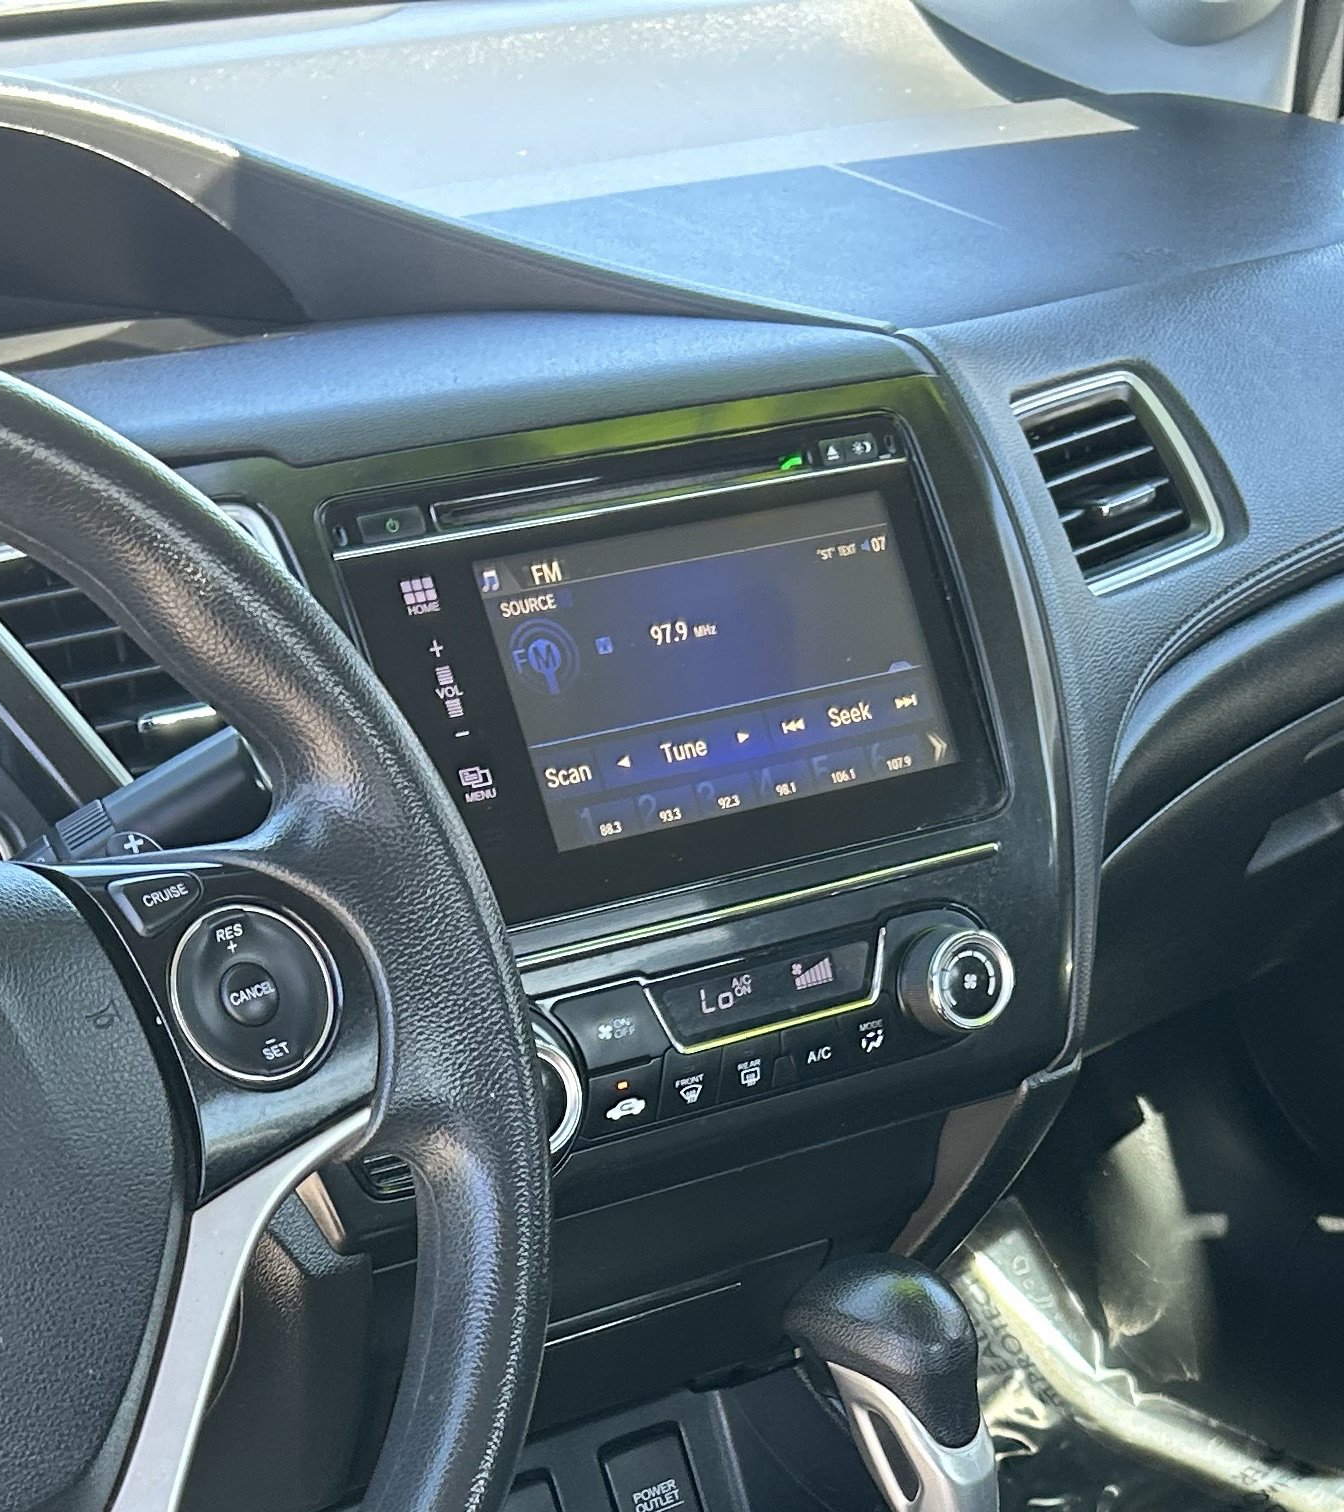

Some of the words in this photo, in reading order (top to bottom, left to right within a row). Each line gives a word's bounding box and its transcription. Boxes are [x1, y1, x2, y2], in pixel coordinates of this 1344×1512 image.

[870, 535, 886, 552] 07
[530, 560, 563, 586] FM
[406, 601, 441, 616] HOME
[500, 593, 558, 618] SOURCE
[650, 621, 689, 646] 97.9
[693, 624, 718, 639] MHz
[435, 685, 464, 701] VOL
[827, 700, 873, 728] Seek
[659, 740, 708, 764] Tune
[885, 755, 912, 772] 107.9
[544, 764, 593, 789] Scan
[830, 768, 857, 784] 106.1
[465, 788, 497, 804] MENU
[774, 781, 797, 797] 98.1
[717, 794, 741, 810] 92.3
[659, 807, 682, 823] 93.3
[599, 820, 623, 837] 88.3
[142, 883, 189, 908] CRUISE
[215, 923, 243, 943] RES
[732, 974, 753, 989] A/C
[229, 981, 276, 1006] CANCEL
[734, 985, 753, 998] ON
[699, 987, 735, 1015] Lo
[613, 1017, 631, 1029] ON
[614, 1025, 636, 1039] OFF
[262, 1041, 291, 1061] SET
[807, 1046, 832, 1064] A/C
[737, 1059, 761, 1071] REAR
[675, 1074, 704, 1088] FRONT
[633, 1479, 677, 1504] POWER
